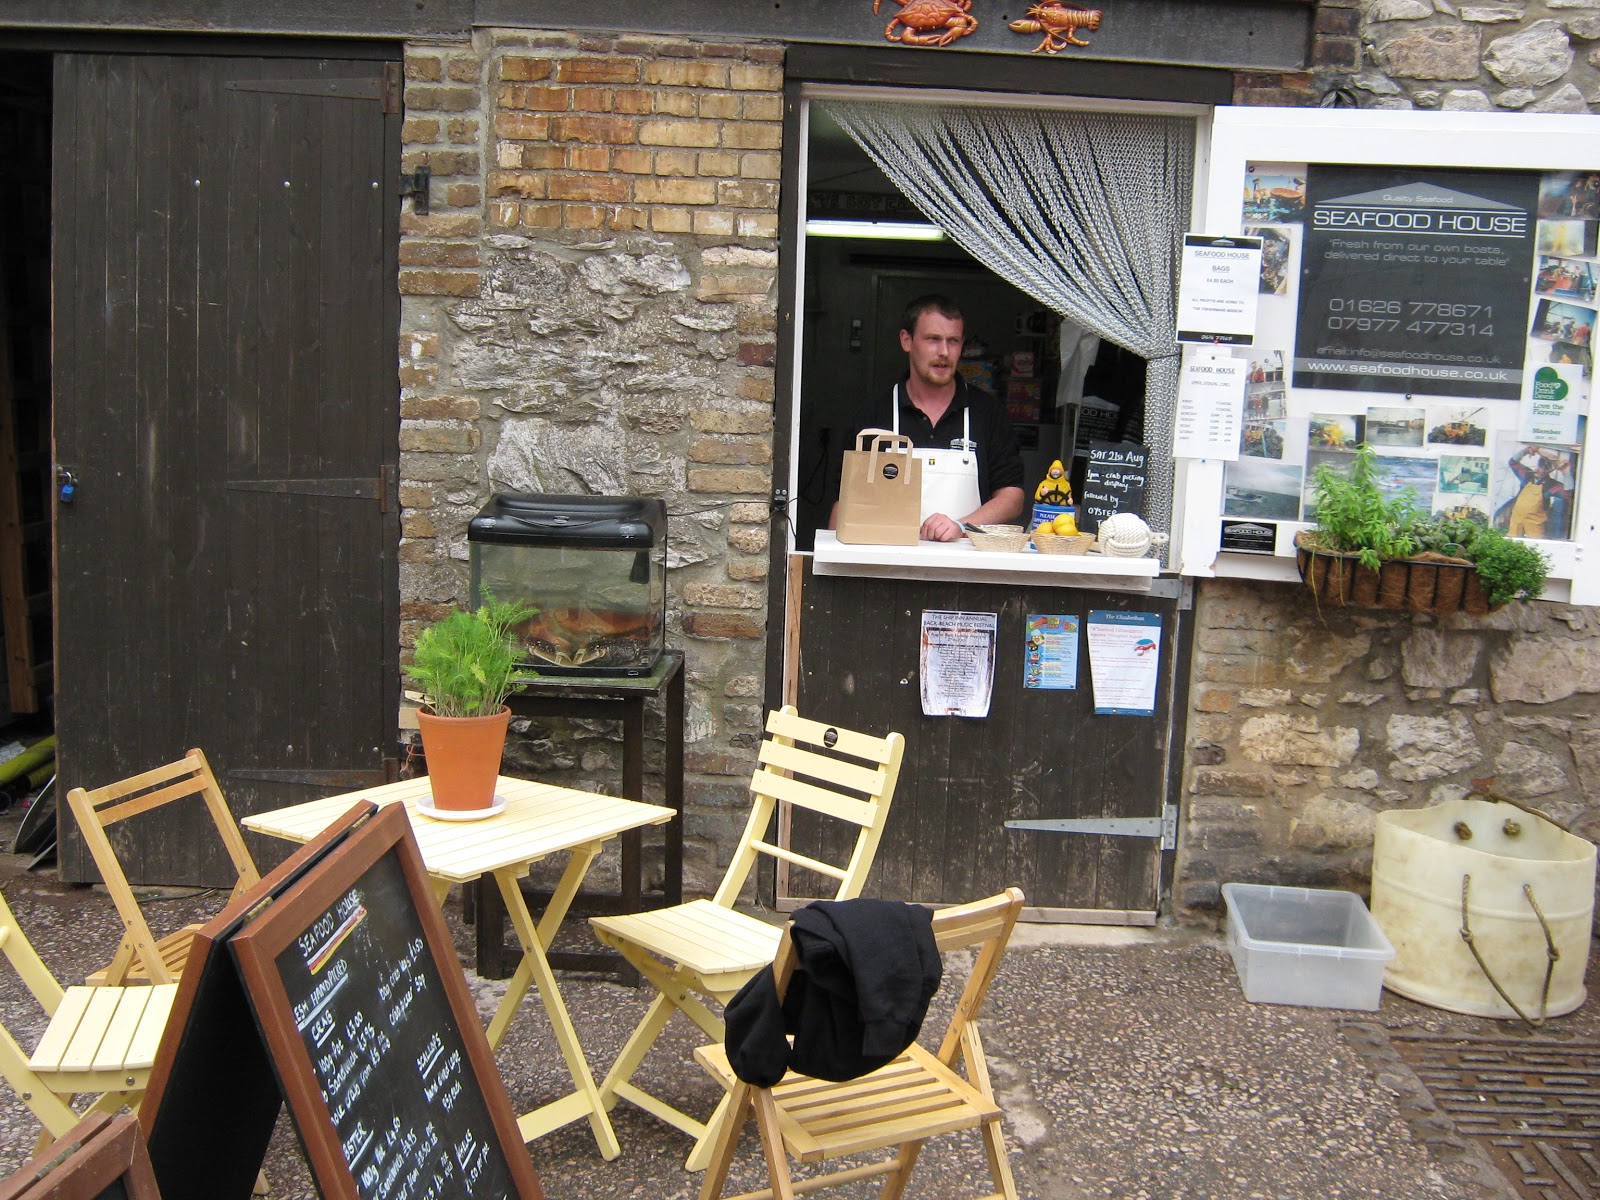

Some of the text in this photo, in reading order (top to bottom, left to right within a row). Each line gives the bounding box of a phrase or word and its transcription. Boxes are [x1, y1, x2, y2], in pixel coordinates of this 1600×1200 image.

[1383, 194, 1453, 204] Quality Seafood
[1313, 210, 1527, 233] SEAFOOD HOUSE
[1194, 250, 1250, 259] SEAFOOD HOUSE
[1324, 250, 1380, 261] delivered
[1383, 252, 1421, 263] direct
[1424, 255, 1438, 263] to
[1441, 257, 1471, 266] your
[1373, 240, 1404, 251] from
[1408, 243, 1430, 252] our
[1433, 245, 1460, 254] own
[1329, 298, 1494, 319] 01626 778671
[1327, 316, 1495, 337] 07977 477314
[1189, 365, 1236, 374] SEAFOOD HOUSE
[1308, 361, 1508, 381] www.seafoodhouse.co.uk
[1532, 408, 1562, 416] Flavour
[1089, 449, 1144, 468] SAT 21st Aug
[1087, 469, 1100, 480] 1pm
[1122, 474, 1145, 487] picking
[1084, 490, 1109, 502] followed
[298, 889, 360, 958] SEAFOOD HOUSE
[294, 959, 348, 1024] ESH HANDPICKED
[311, 1009, 334, 1041] CRAB
[318, 1053, 336, 1075] 100g
[331, 1038, 344, 1059] Pot
[416, 1032, 442, 1072] SCALLOPS
[328, 1050, 359, 1096] Sandwich
[360, 1063, 373, 1087] from
[342, 1121, 367, 1161] BSTER
[361, 1164, 380, 1189] 100g
[378, 1153, 405, 1199] Sandwich
[406, 1167, 420, 1193] from
